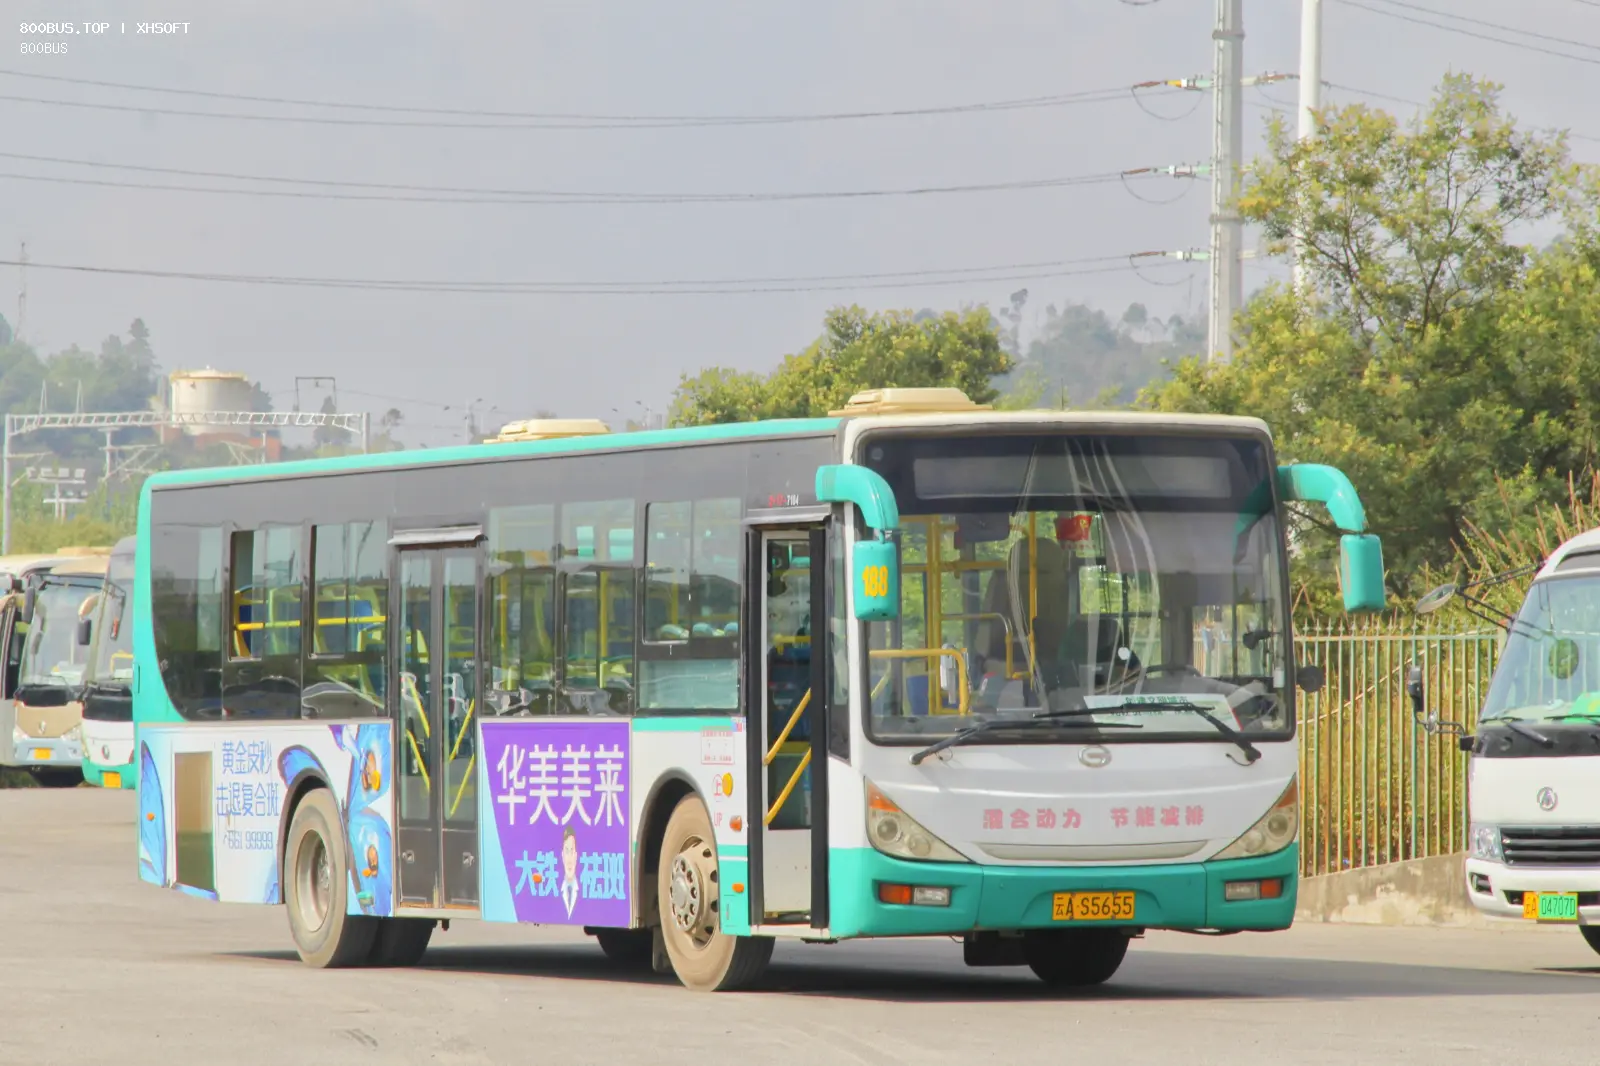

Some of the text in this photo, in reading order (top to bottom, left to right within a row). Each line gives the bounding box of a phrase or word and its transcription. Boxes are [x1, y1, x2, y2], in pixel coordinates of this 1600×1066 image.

[862, 565, 888, 597] 188
[222, 740, 273, 775] 黄金皮秒
[497, 744, 625, 827] 华美美莱
[983, 805, 1205, 830] 混合动力 节能减排
[579, 851, 626, 900] 祛斑
